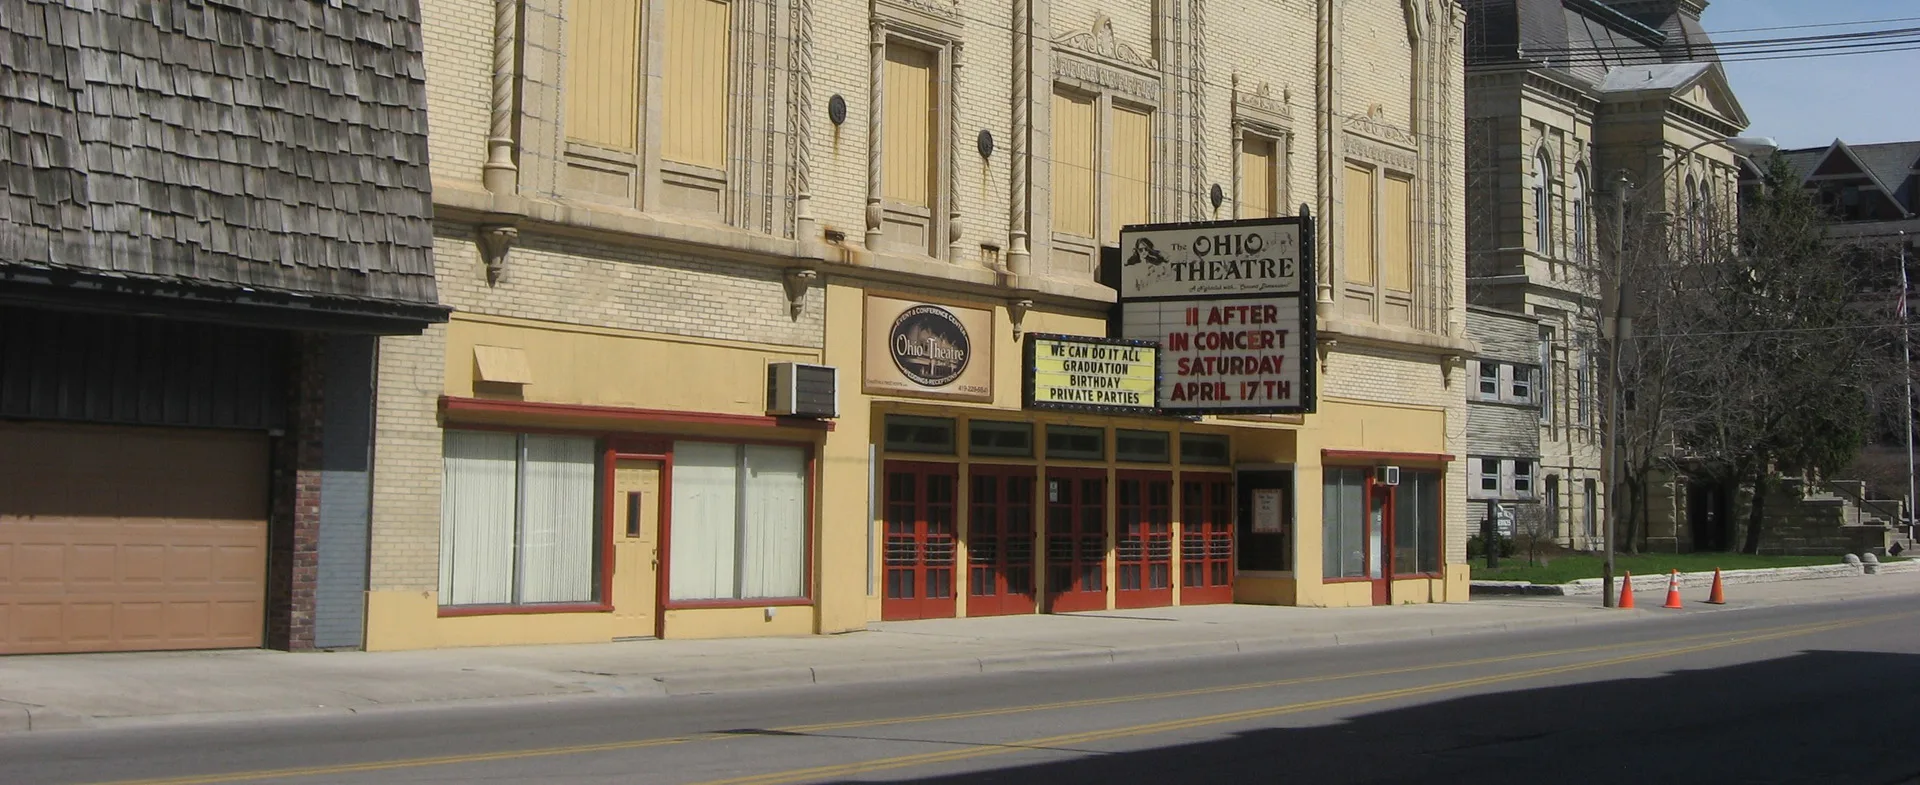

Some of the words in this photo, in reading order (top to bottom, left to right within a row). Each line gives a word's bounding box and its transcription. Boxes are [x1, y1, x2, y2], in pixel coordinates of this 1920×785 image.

[1171, 242, 1187, 251] The
[1193, 233, 1263, 257] OHIO
[1171, 257, 1294, 282] THEATRE
[948, 314, 967, 336] CENTER
[1207, 304, 1277, 325] AFTER
[896, 333, 923, 357] Ohio
[926, 337, 964, 361] Theatre
[1169, 332, 1189, 351] IN
[1194, 329, 1289, 351] CONCERT
[1051, 344, 1065, 357] WE
[1068, 346, 1088, 359] CAN
[1092, 348, 1105, 360] DO
[1109, 349, 1120, 360] IT
[1122, 349, 1141, 362] ALL
[1063, 360, 1128, 375] GRADUATION
[1177, 355, 1284, 376] SATURDAY
[1070, 374, 1121, 389] BIRTHDAY
[1170, 382, 1231, 402] APRIL
[1050, 387, 1094, 402] PRIVATE
[1097, 390, 1140, 405] PARTIES
